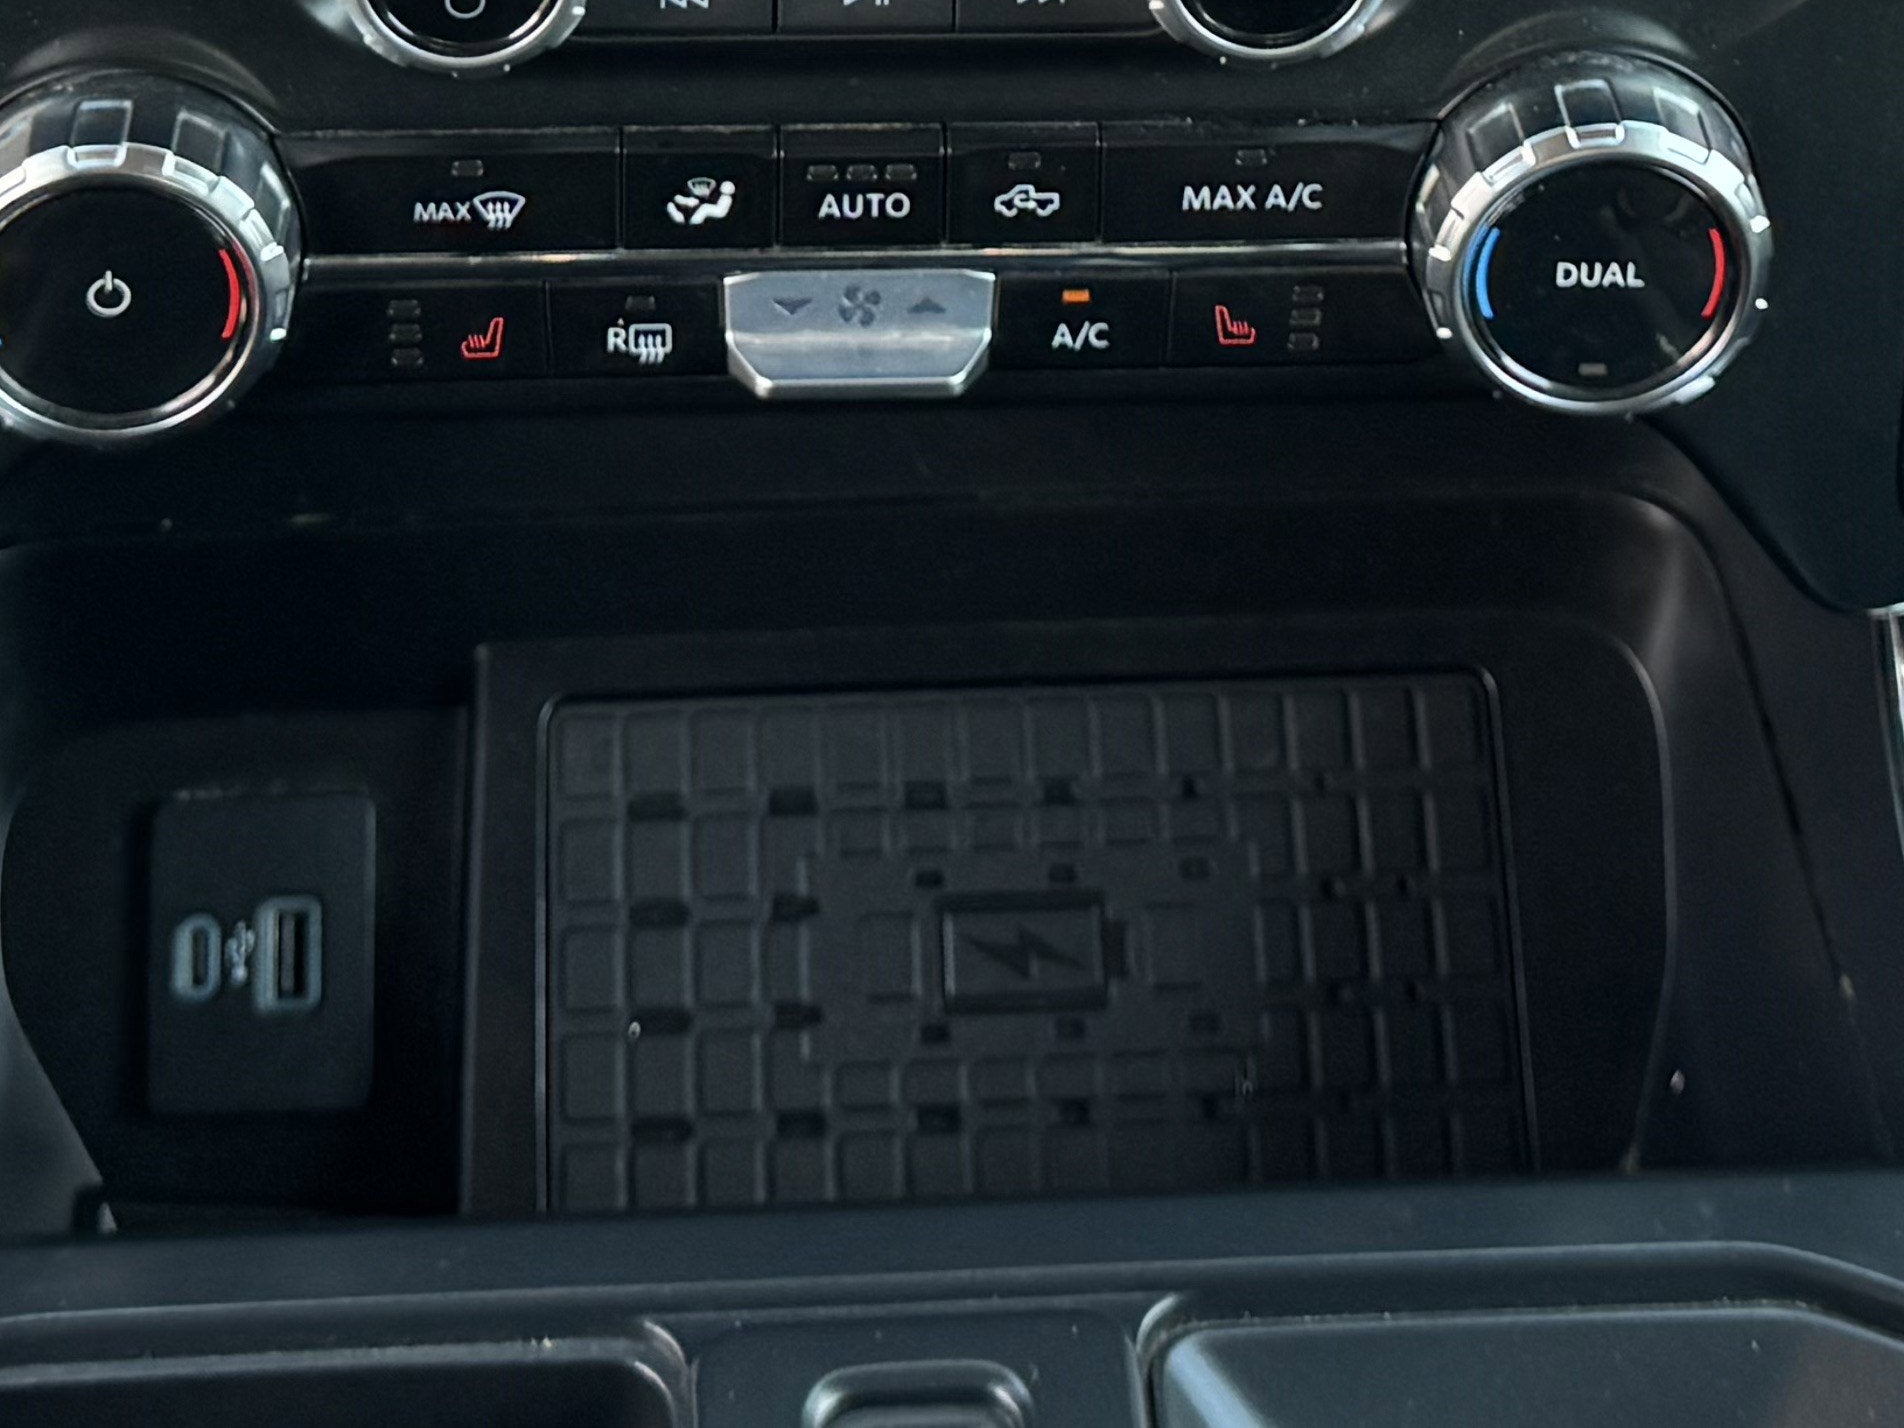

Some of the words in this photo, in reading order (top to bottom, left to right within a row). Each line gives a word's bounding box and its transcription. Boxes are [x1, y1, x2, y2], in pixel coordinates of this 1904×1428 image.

[818, 192, 911, 219] AUTO
[1182, 184, 1256, 211] MAX
[1264, 182, 1323, 212] A/C
[414, 200, 471, 224] MAX
[1555, 261, 1645, 288] DUAL
[1051, 320, 1109, 350] A/C
